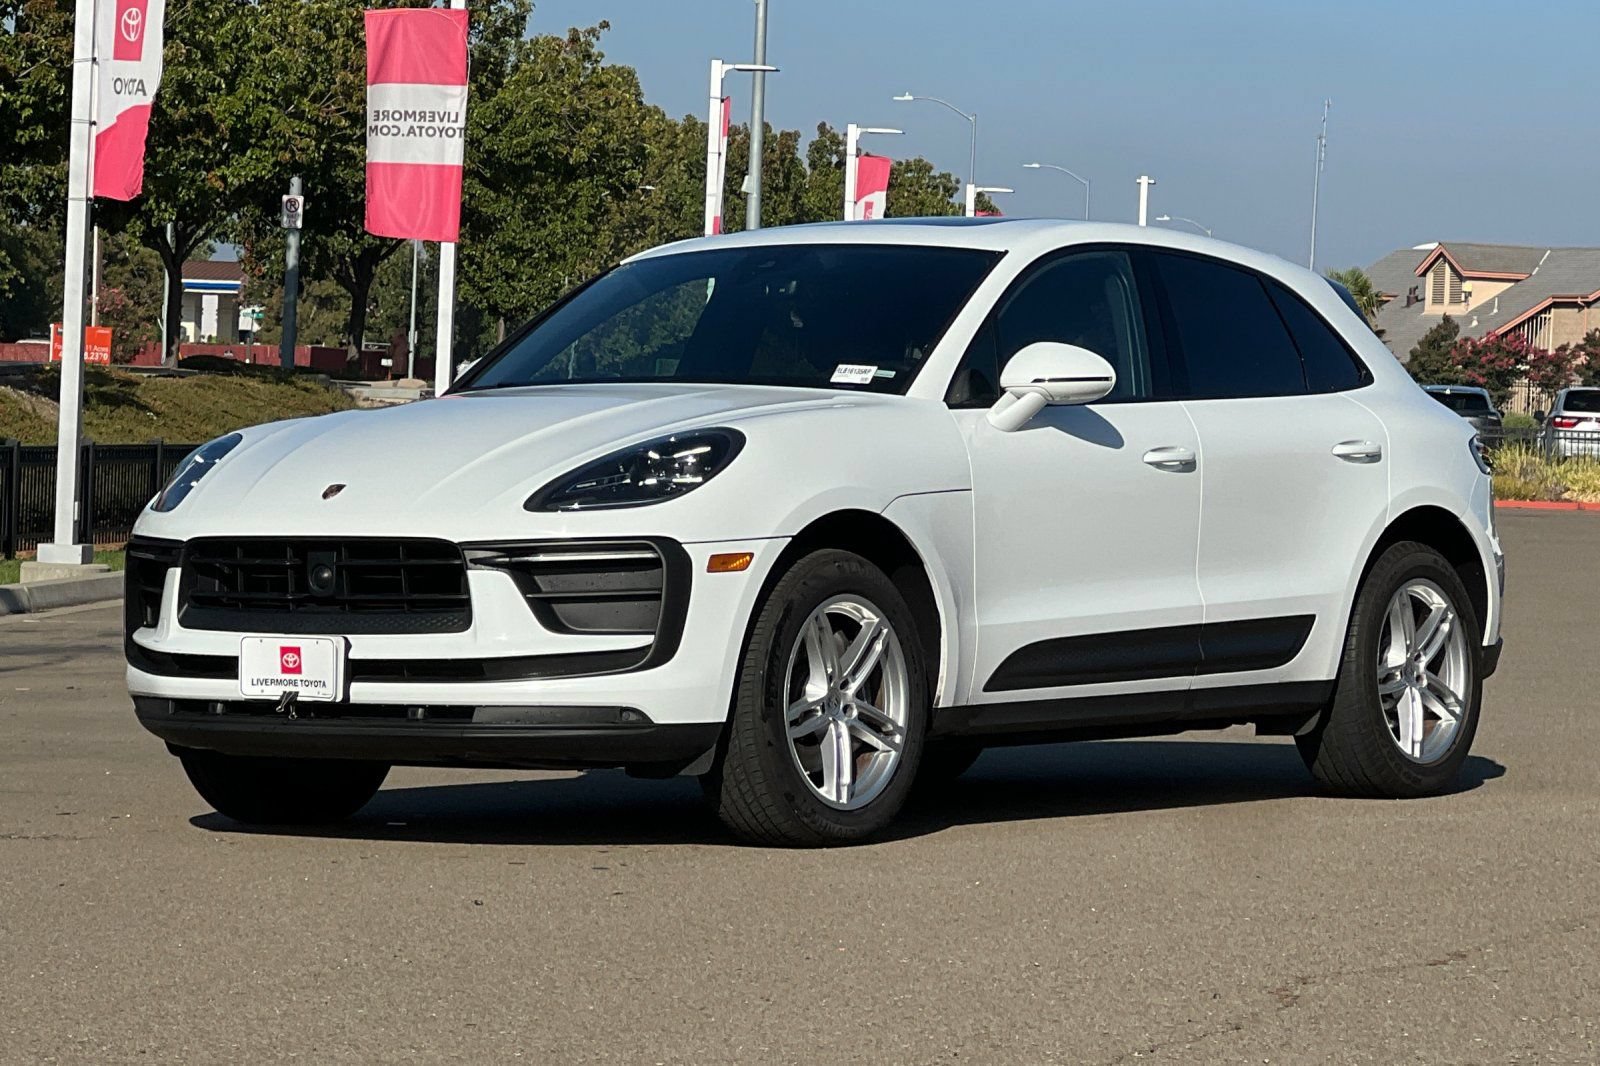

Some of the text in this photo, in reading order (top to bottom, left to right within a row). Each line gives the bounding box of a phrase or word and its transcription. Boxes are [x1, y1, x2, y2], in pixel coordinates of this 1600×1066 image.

[112, 77, 147, 97] OYOTA
[251, 678, 327, 688] LIVERMORE TOYOTA
